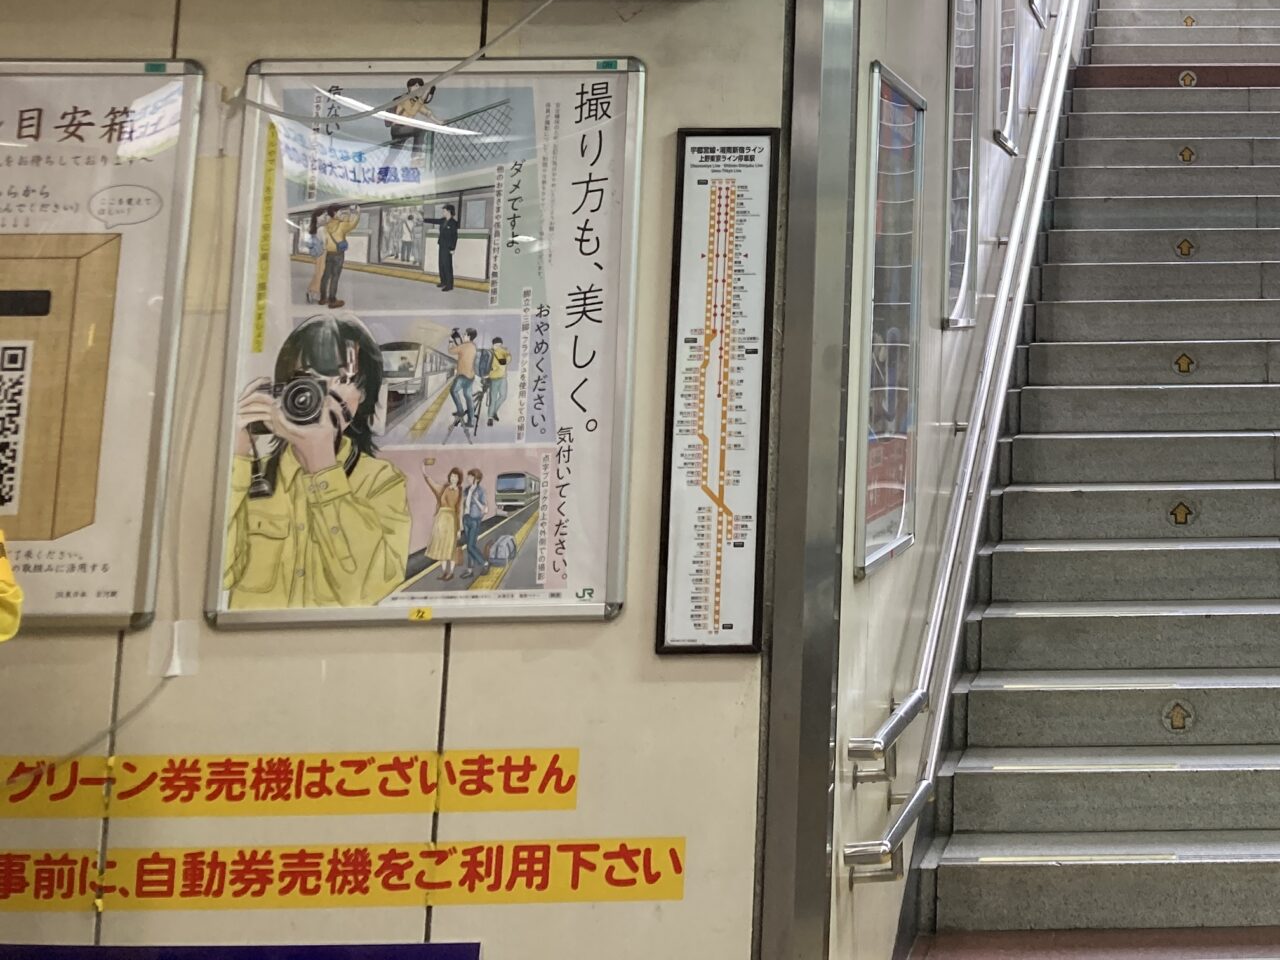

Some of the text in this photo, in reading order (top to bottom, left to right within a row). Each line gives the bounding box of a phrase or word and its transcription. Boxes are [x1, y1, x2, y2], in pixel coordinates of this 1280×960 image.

[0, 106, 136, 144] 目安箱
[0, 185, 50, 198] らから
[565, 81, 612, 432] 撮り方も、美しく。
[531, 303, 551, 435] おやめください。
[553, 426, 574, 581] 気付いてください。
[576, 588, 594, 599] JR
[7, 753, 576, 803] グリーン券売機はございません
[0, 843, 683, 900] 事前に、自動券売機をご利用下さい
